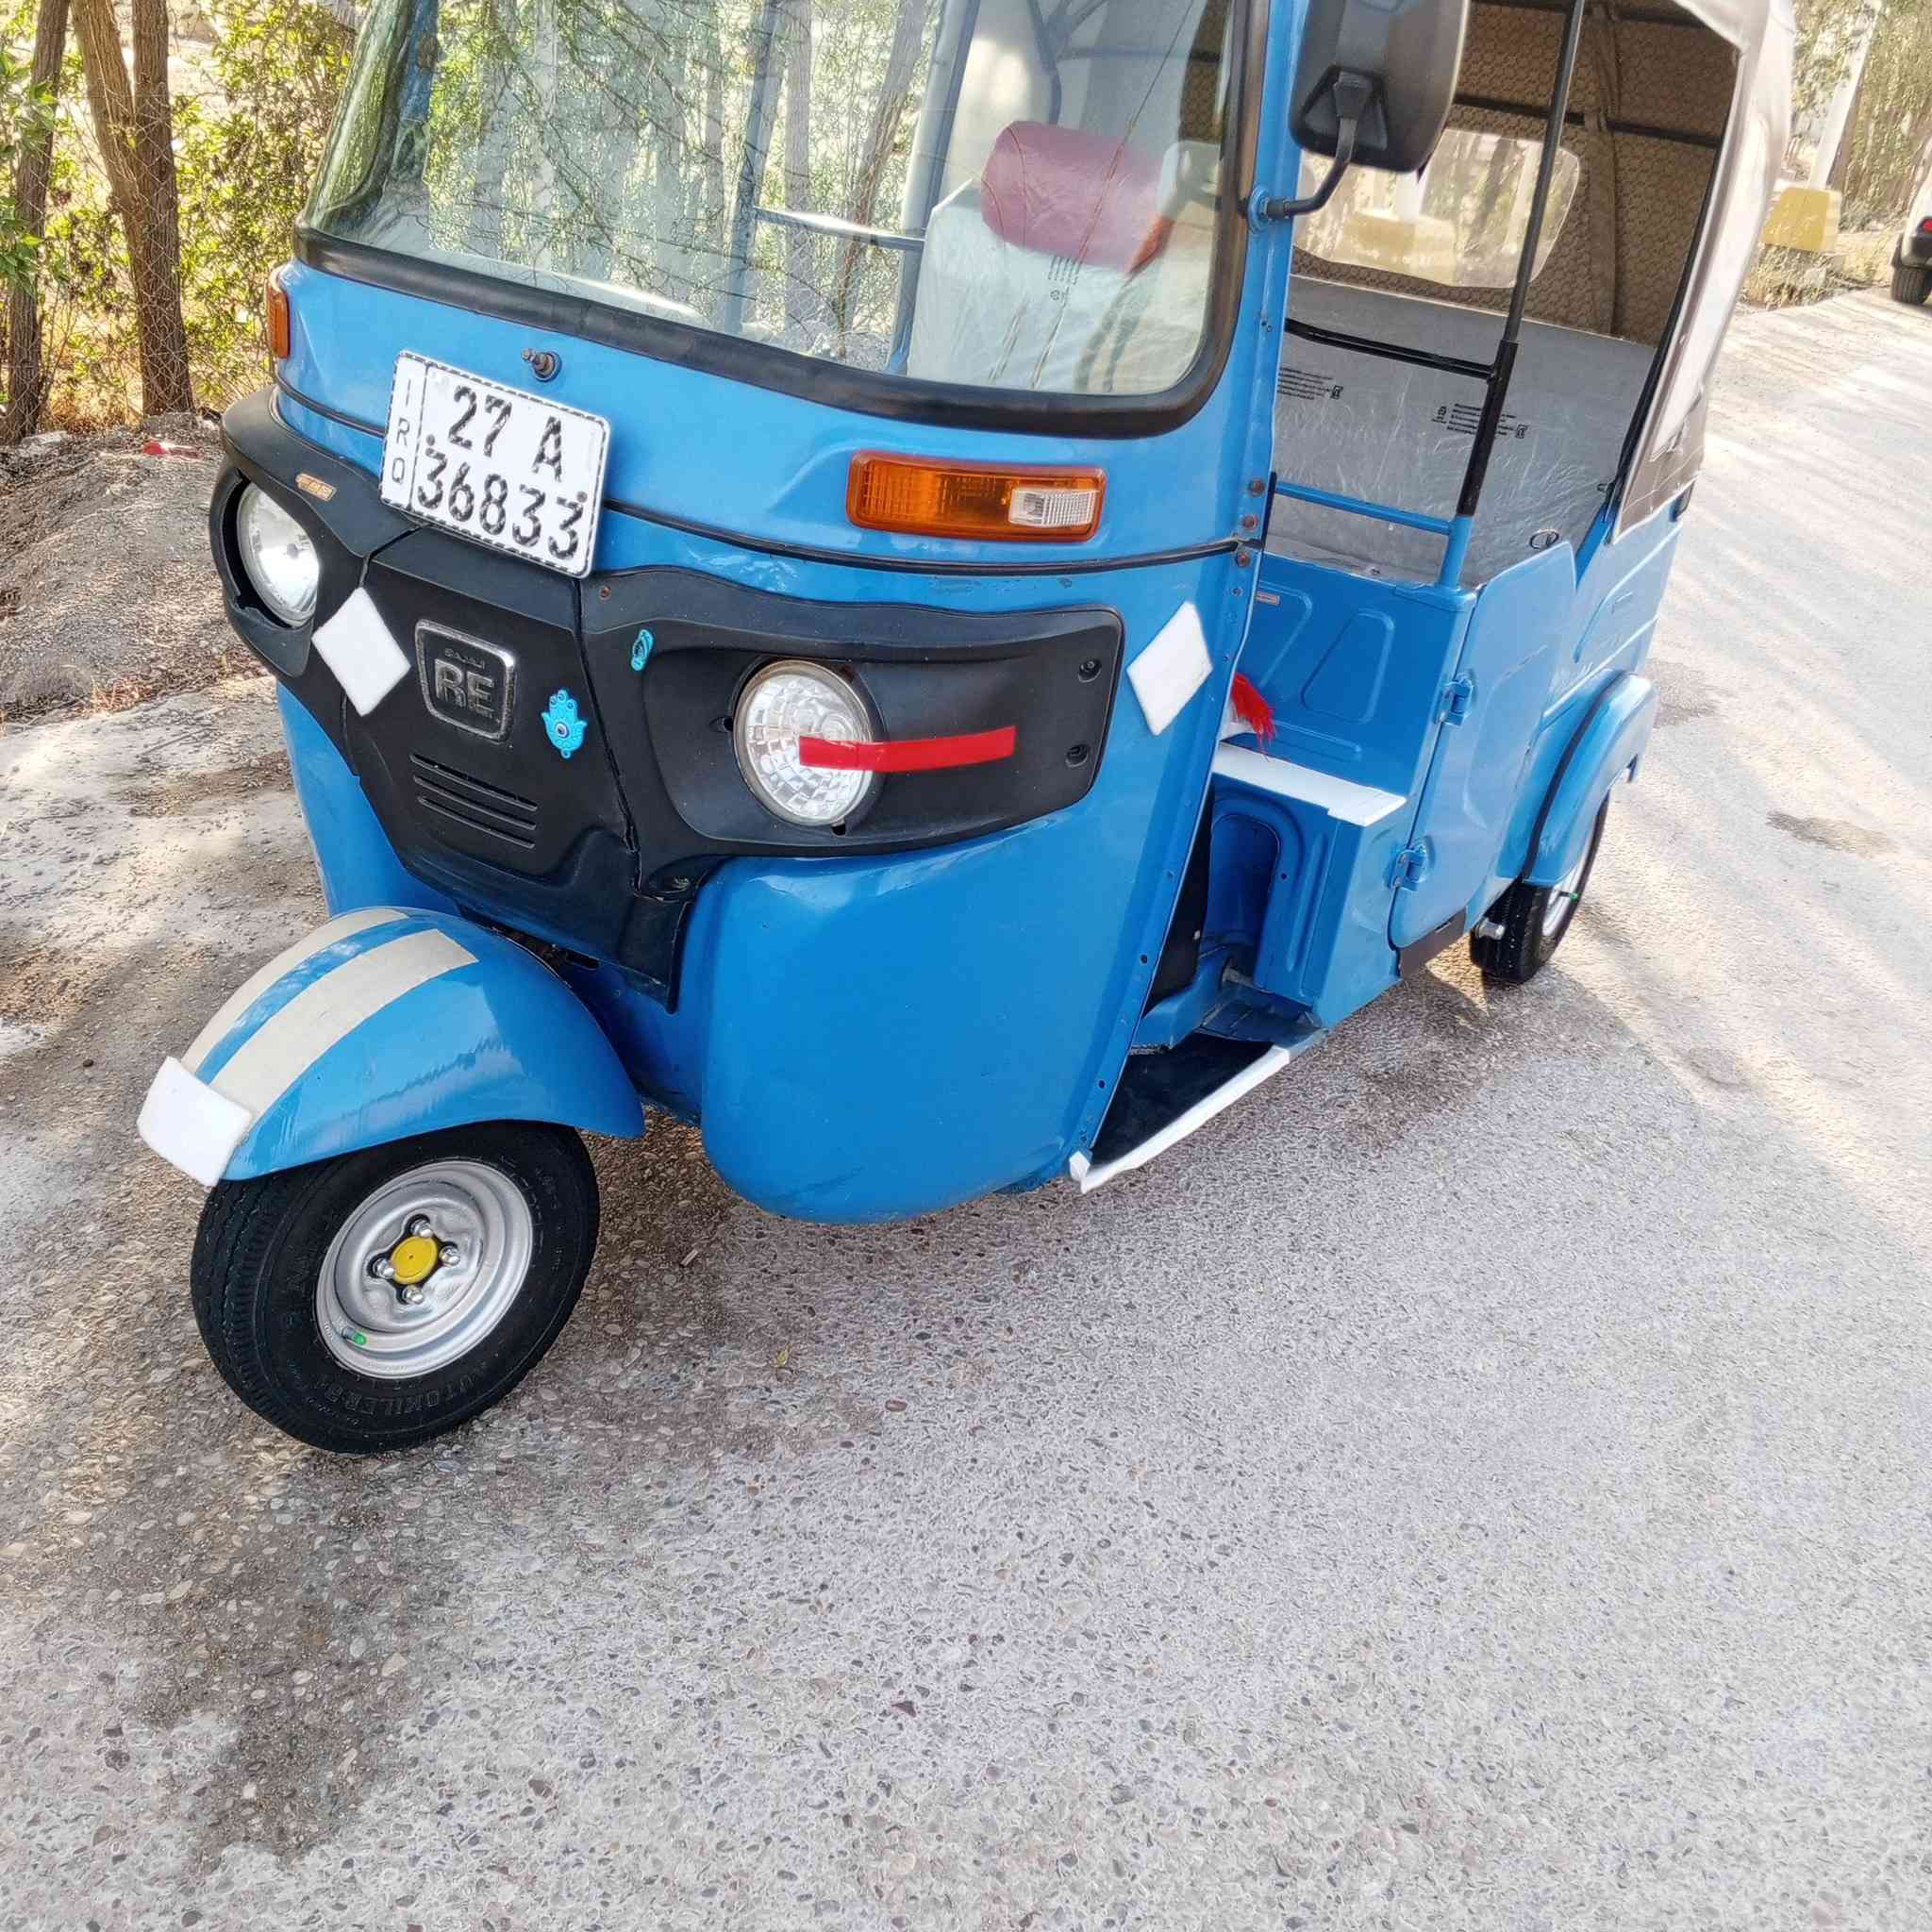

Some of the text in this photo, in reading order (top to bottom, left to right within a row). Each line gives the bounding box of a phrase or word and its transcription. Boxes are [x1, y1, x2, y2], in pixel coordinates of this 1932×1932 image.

[391, 378, 412, 484] IRQ
[448, 385, 563, 483] 27 A
[417, 448, 583, 559] 36833
[434, 658, 495, 718] RE
